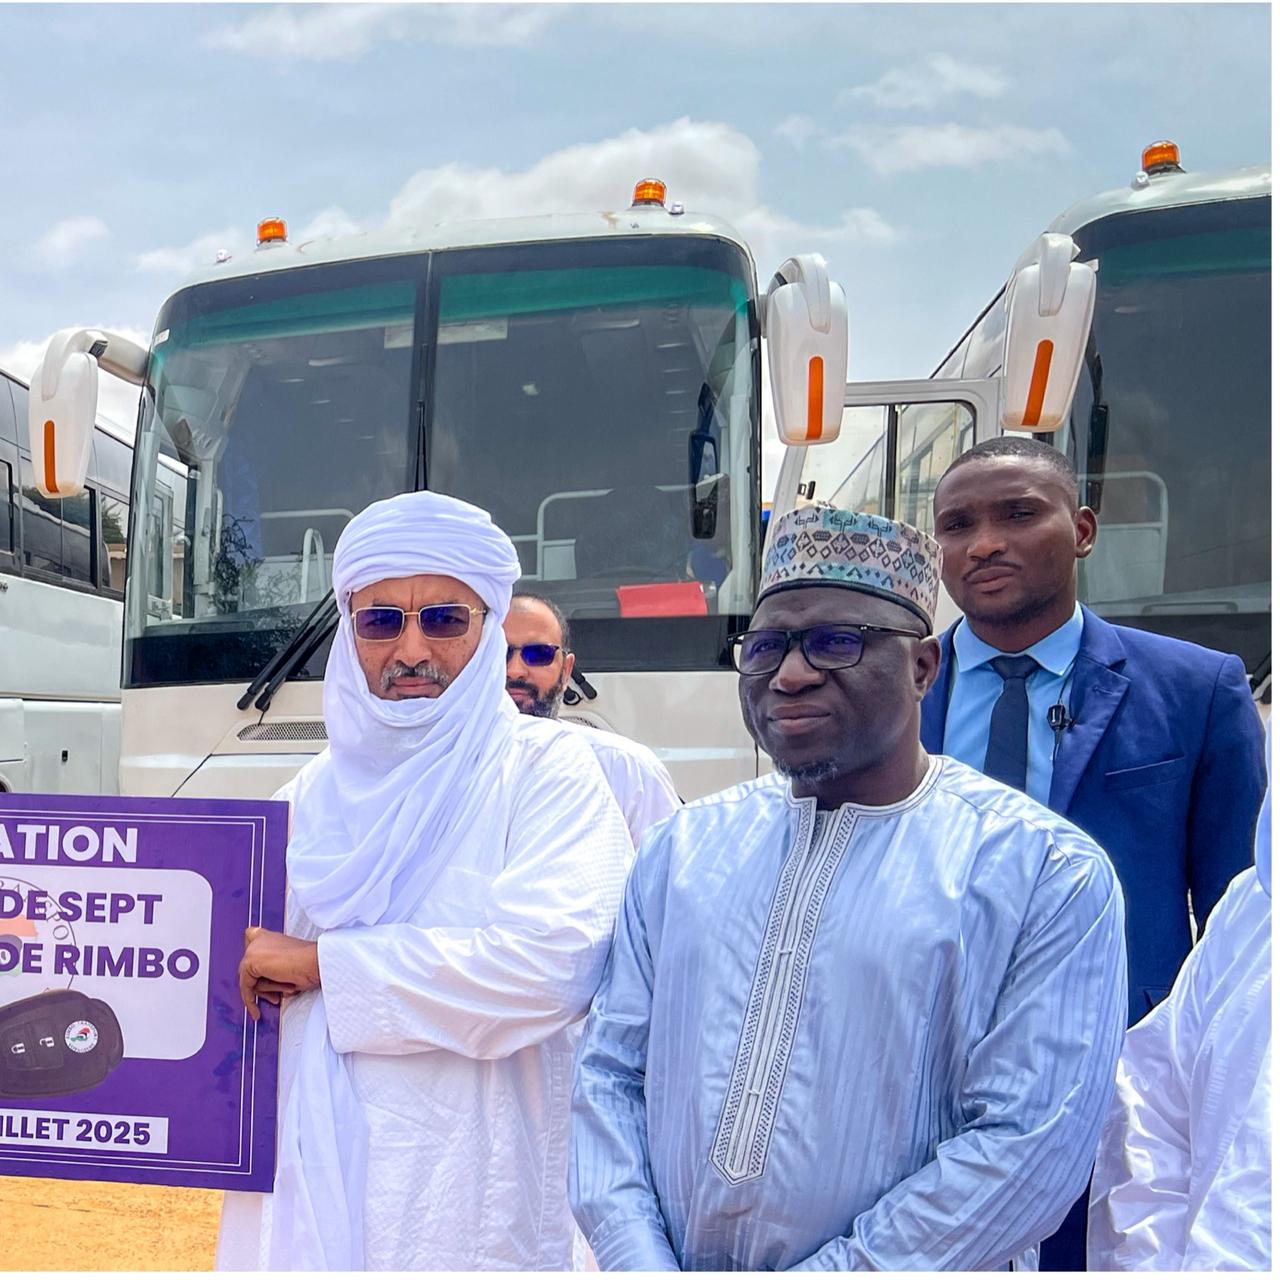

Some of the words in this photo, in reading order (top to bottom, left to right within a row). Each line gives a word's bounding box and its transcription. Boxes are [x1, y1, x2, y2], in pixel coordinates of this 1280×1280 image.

[57, 891, 163, 924] SEPT
[54, 944, 200, 980] RIMBO
[75, 1118, 151, 1146] 2025
